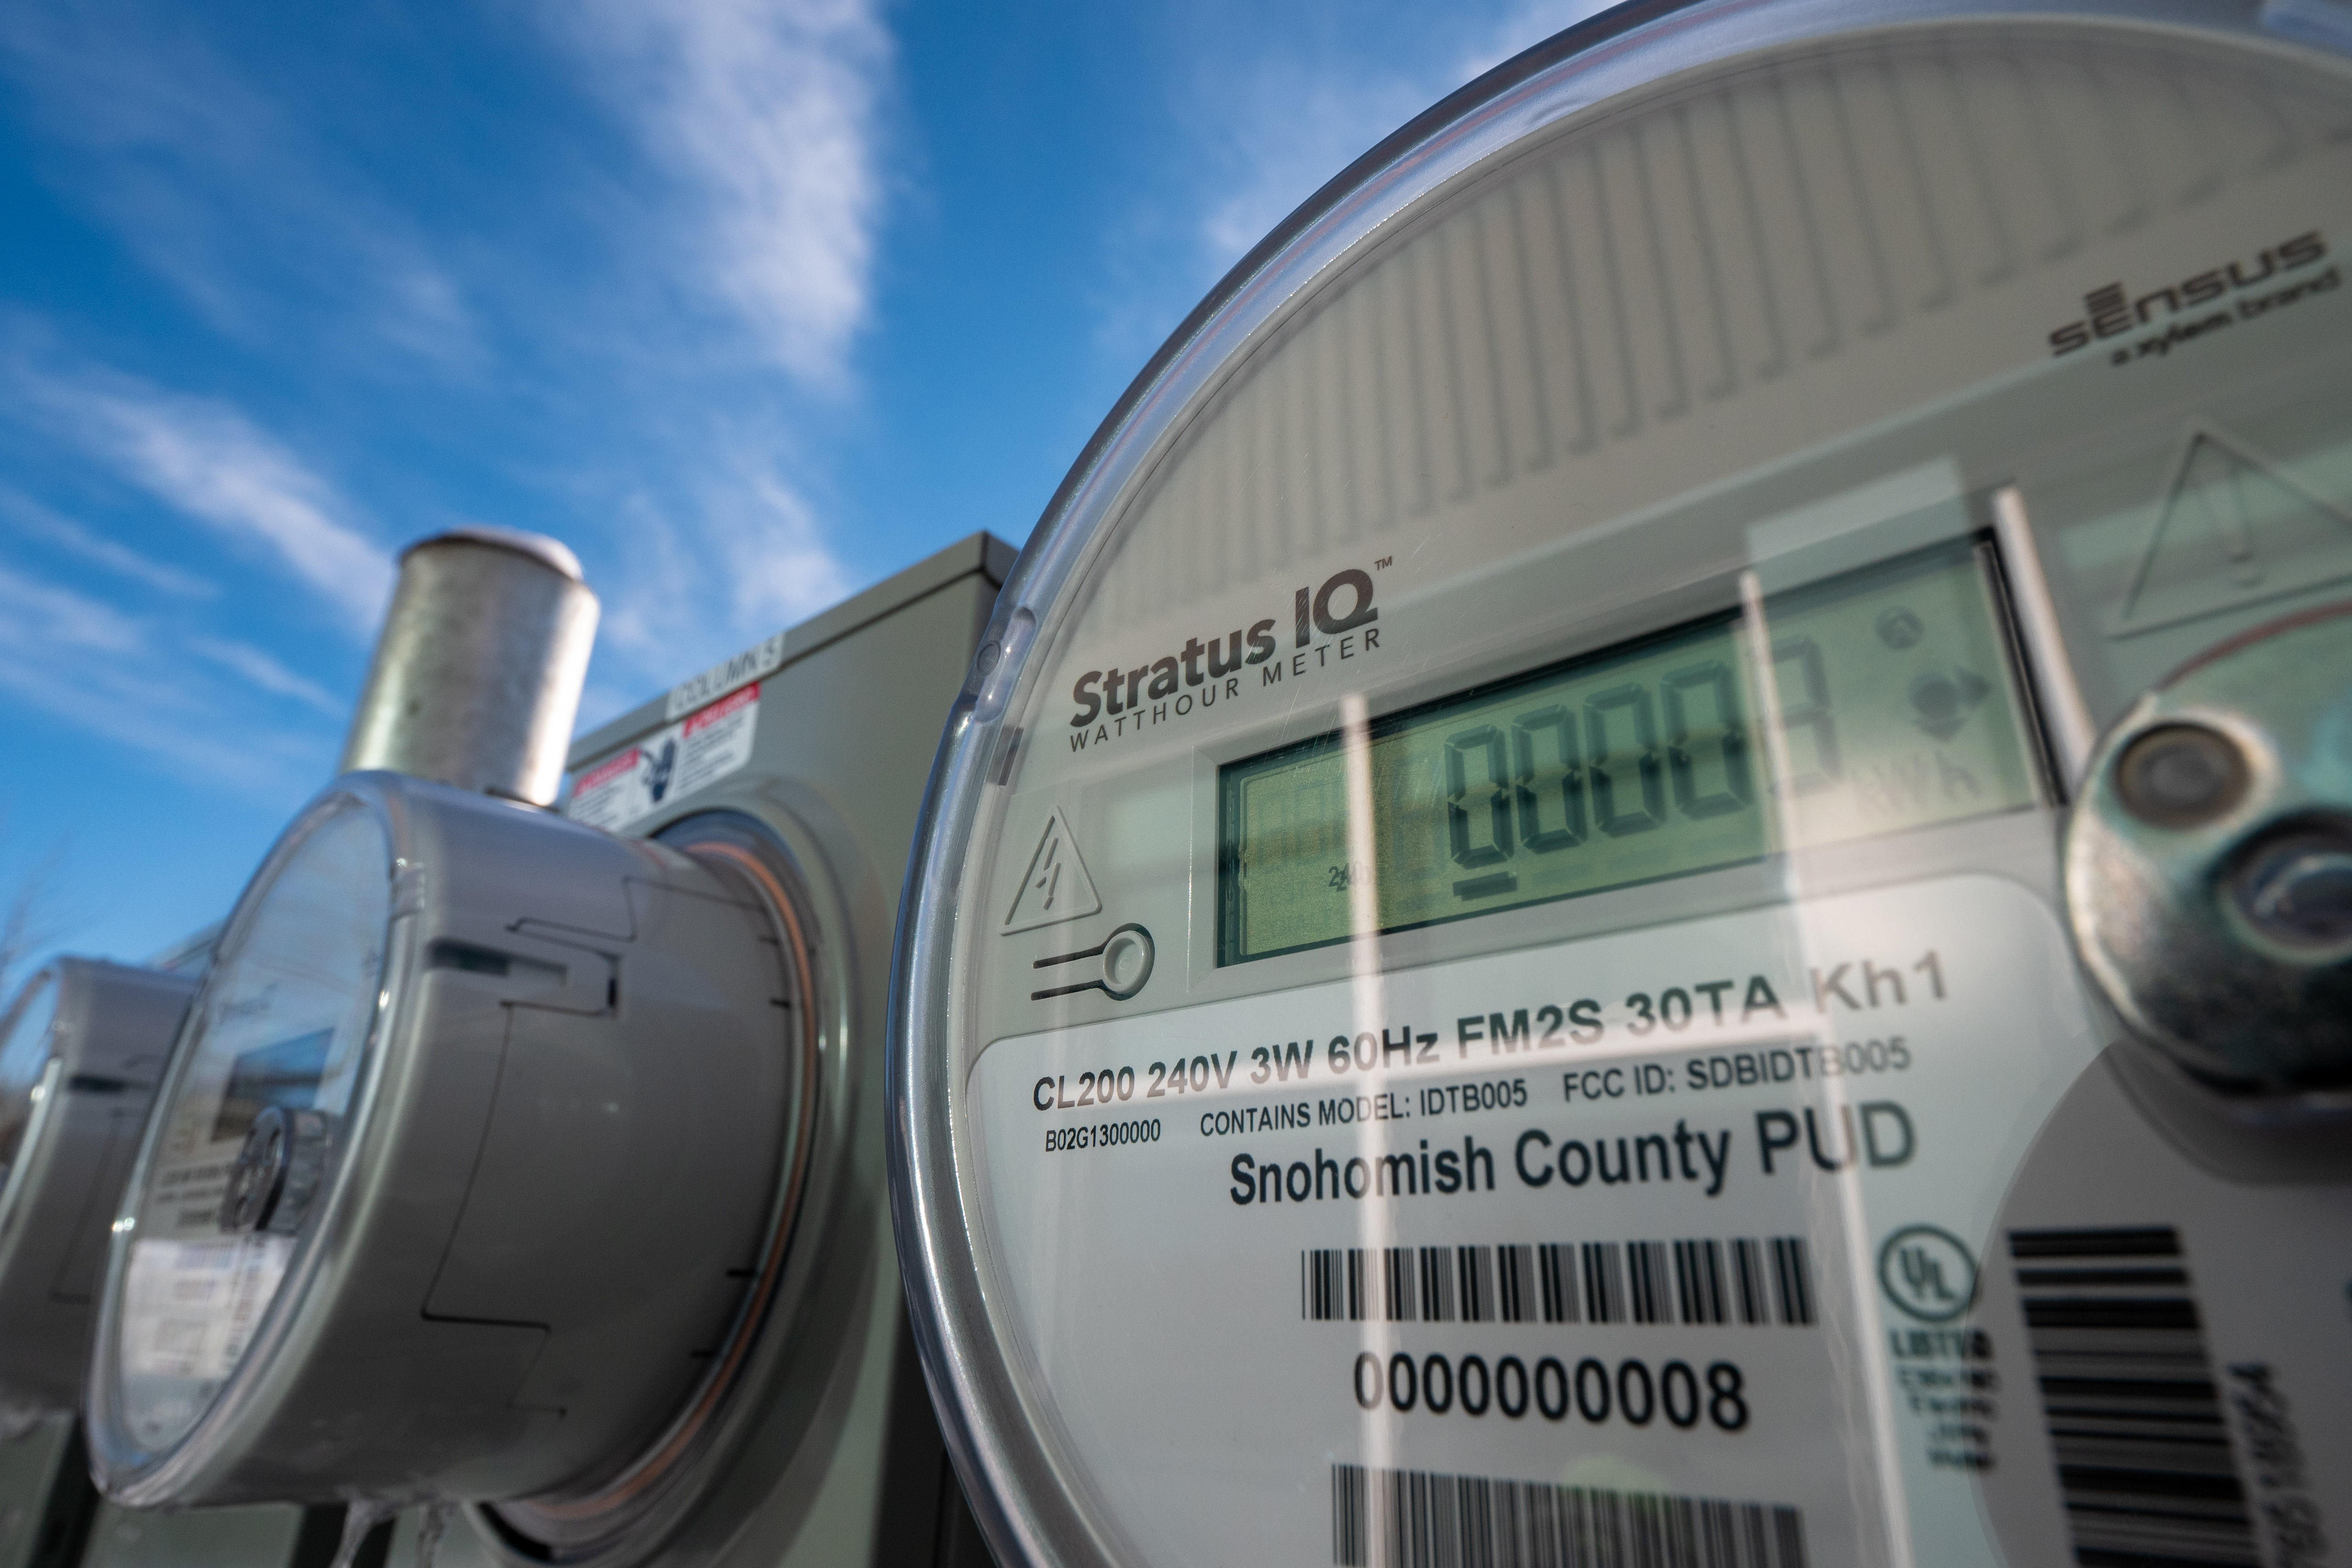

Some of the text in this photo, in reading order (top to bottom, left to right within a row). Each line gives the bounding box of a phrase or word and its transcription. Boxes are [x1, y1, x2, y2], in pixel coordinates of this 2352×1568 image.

[1070, 618, 1276, 727] Stratus
[1070, 628, 1380, 752] WATTHOUR METER
[1033, 1065, 1135, 1111] CL200
[1147, 1051, 1237, 1098] 240V
[1250, 1040, 1313, 1084] 3W
[1328, 1026, 1440, 1075] 60Hz
[1457, 998, 1605, 1059] FM2S
[1625, 974, 1787, 1036] 30TA
[1045, 1036, 1912, 1152] B02G1300000 CONTAINS MODEL: IDTB005 FCC ID: SDBIDTB005
[1230, 1099, 1917, 1205] Snohomish County PUD
[1353, 1351, 1750, 1431] 0000000008
